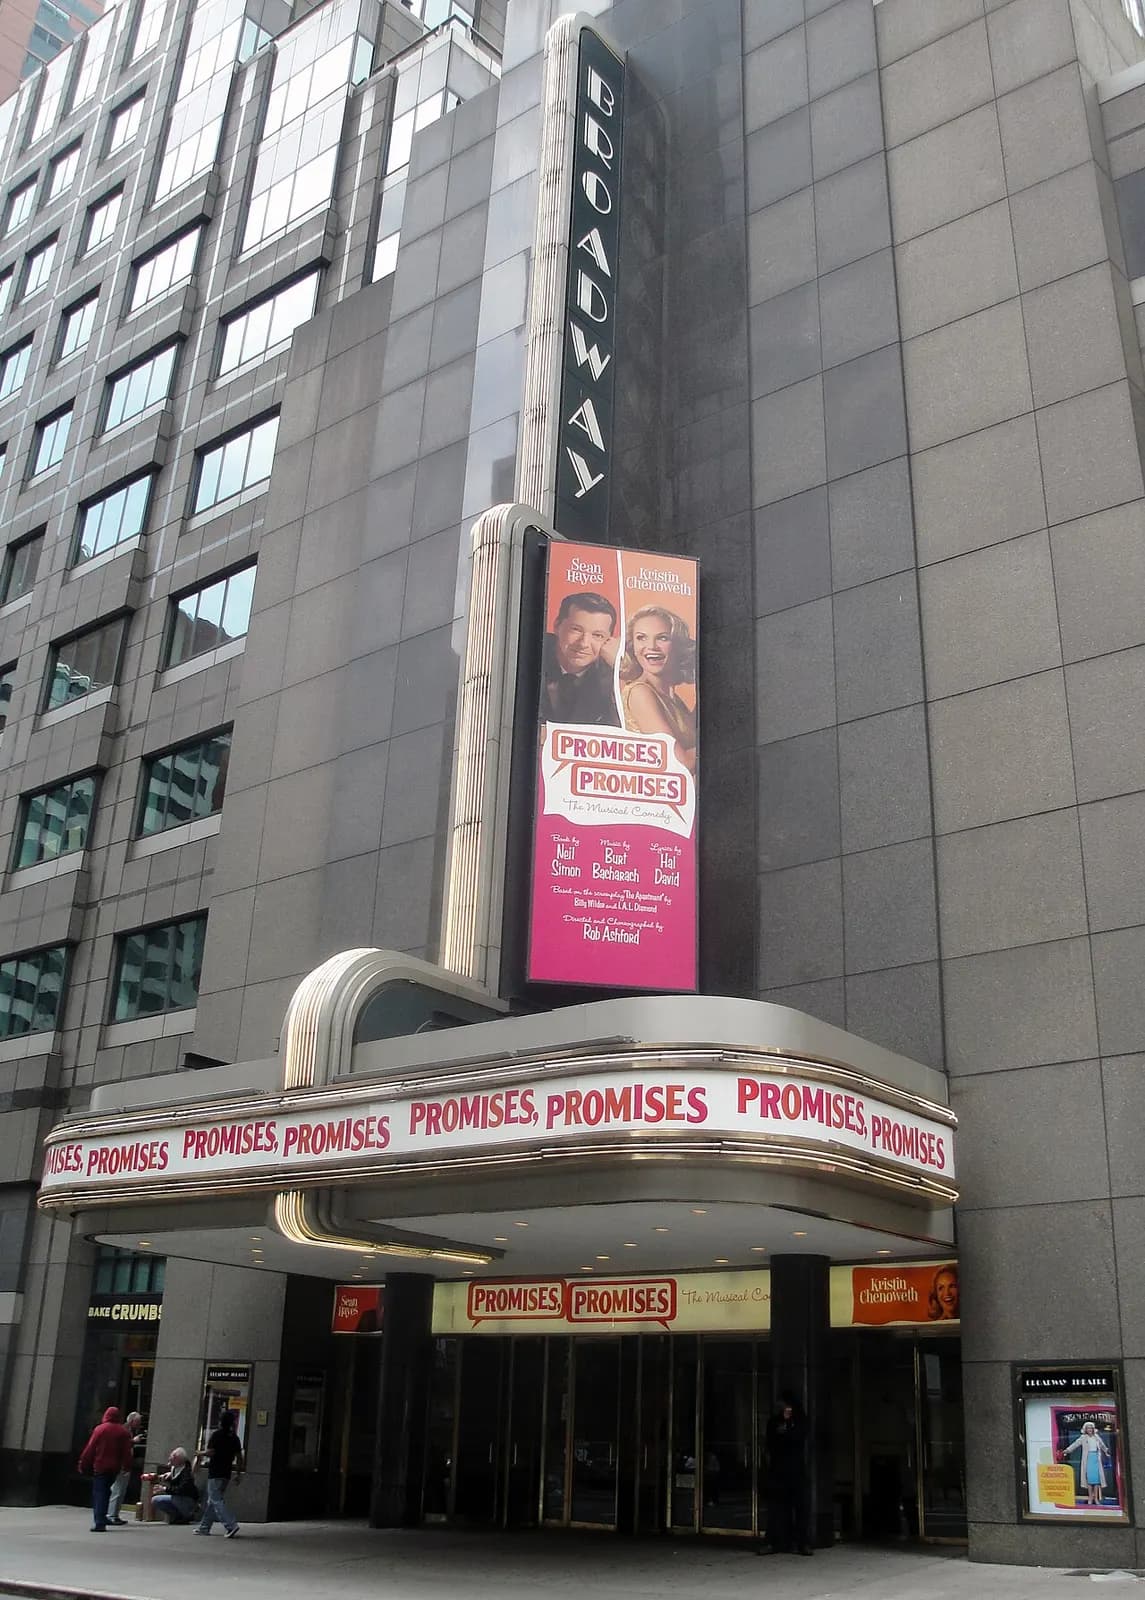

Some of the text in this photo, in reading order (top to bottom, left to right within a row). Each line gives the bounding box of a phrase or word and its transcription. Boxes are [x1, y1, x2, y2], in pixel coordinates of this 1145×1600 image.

[566, 65, 614, 498] BROADWAY
[571, 558, 602, 574] Sean
[639, 567, 679, 584] Kristin
[566, 569, 604, 585] Hayes
[626, 577, 692, 596] Chenoweth
[560, 735, 662, 767] PROMISES,
[580, 771, 679, 799] PROMISES
[563, 798, 672, 824] The Musical Comedy
[556, 844, 575, 860] Neil
[605, 847, 628, 865] Burt
[660, 853, 676, 869] Hal
[551, 859, 581, 877] Simon
[592, 862, 640, 882] Bacharach
[654, 868, 680, 887] David
[583, 923, 640, 945] Rob Ashford
[409, 1084, 708, 1136] PROMISES, PROMISES
[737, 1077, 945, 1170] PROMISES, PROMISES
[183, 1115, 391, 1160] PROMISES, PROMISES
[87, 1141, 169, 1177] PROMISES
[871, 1277, 907, 1292] Kristin
[474, 1286, 562, 1314] PROMISES,
[574, 1286, 669, 1315] PROMISES
[681, 1288, 702, 1305] The
[704, 1288, 749, 1304] Musical
[860, 1287, 918, 1304] Chenoweth
[88, 1306, 110, 1317] BAKE
